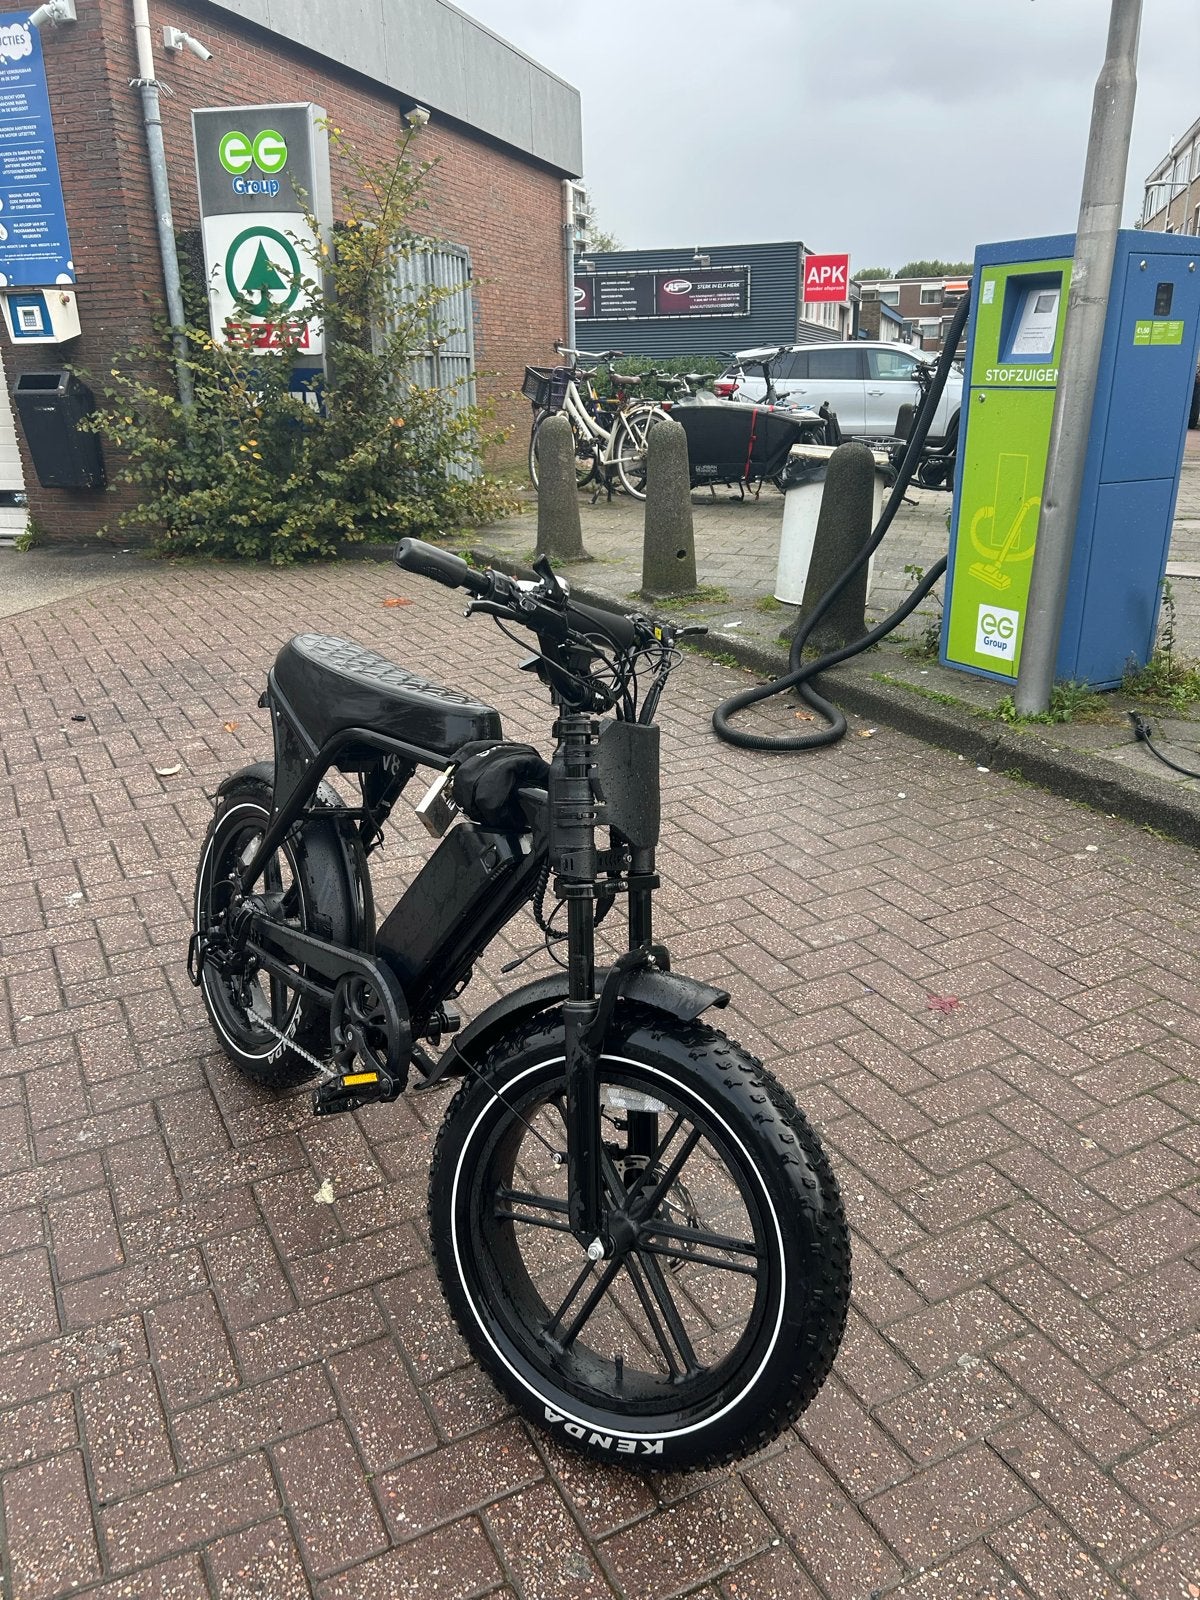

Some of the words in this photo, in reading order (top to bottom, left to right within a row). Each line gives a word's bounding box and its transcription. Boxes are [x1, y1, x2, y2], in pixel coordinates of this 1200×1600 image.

[233, 176, 279, 197] Group
[807, 265, 845, 284] APK
[983, 636, 1008, 651] Group
[382, 752, 401, 776] V8
[544, 1405, 664, 1455] KENDA
